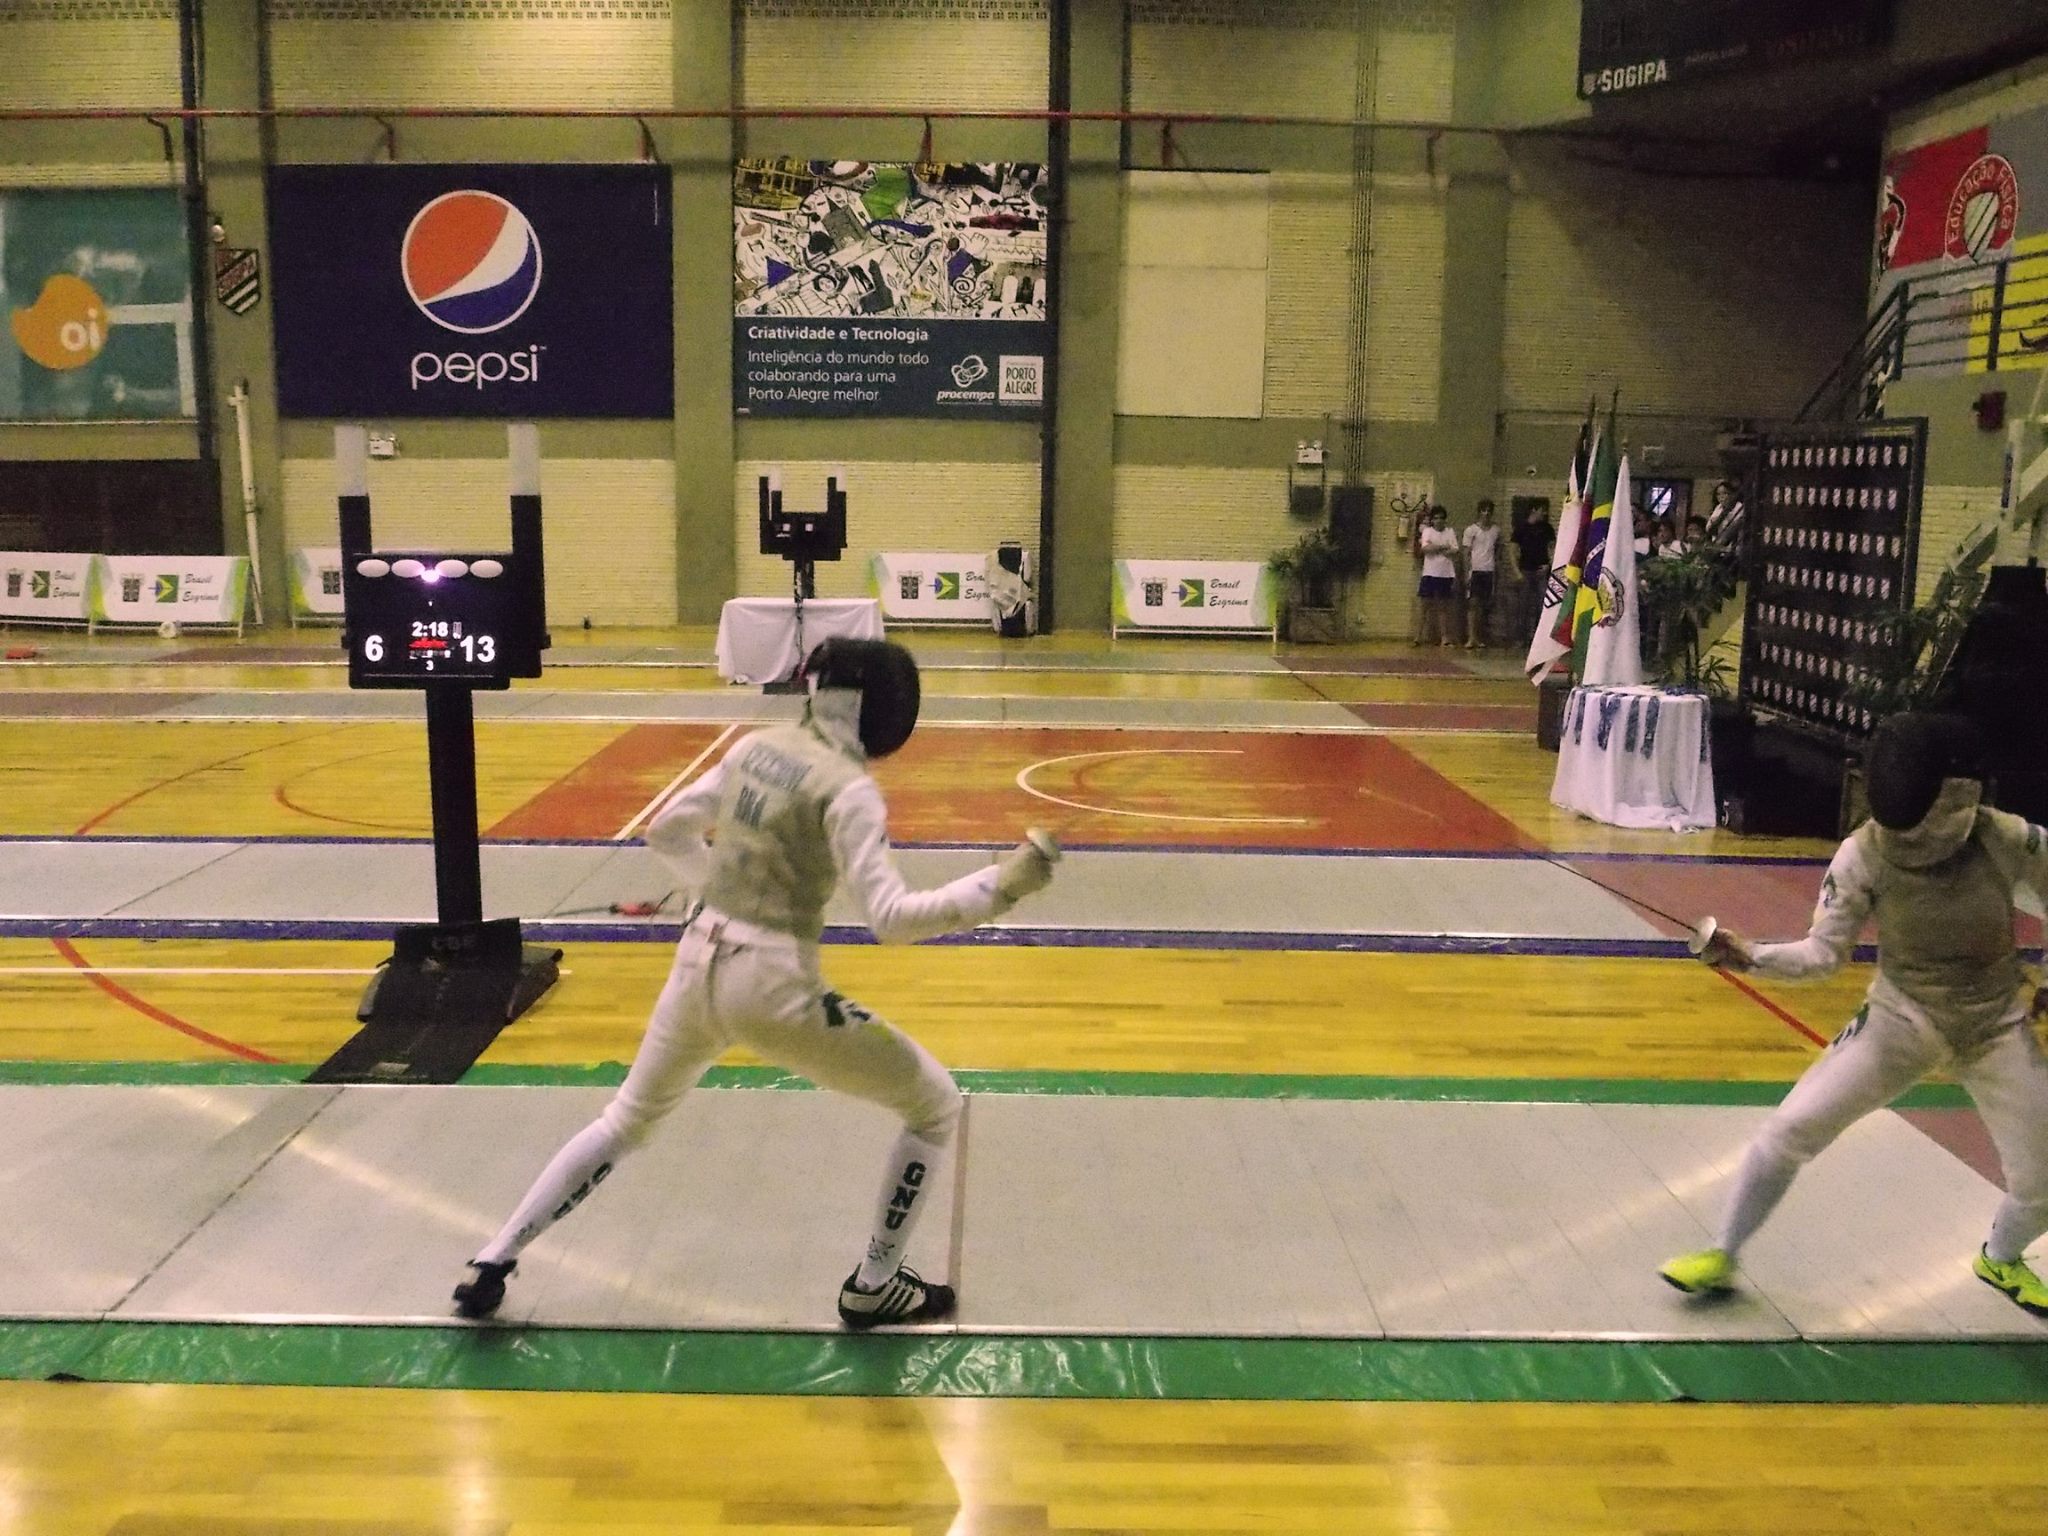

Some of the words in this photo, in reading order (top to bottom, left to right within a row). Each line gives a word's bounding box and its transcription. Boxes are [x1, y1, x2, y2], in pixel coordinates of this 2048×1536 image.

[1601, 59, 1666, 91] SOGIPA
[61, 308, 100, 352] oi
[748, 326, 835, 340] Criatividade
[839, 330, 848, 340] e
[852, 327, 929, 344] Tecnologia
[748, 350, 823, 366] Inteligência
[826, 351, 844, 364] do
[847, 352, 895, 364] mundo
[899, 352, 929, 365] todo
[411, 344, 538, 390] pepsi
[1006, 367, 1037, 381] PORTO
[748, 369, 830, 382] colaborando
[834, 371, 863, 384] para
[867, 373, 896, 383] uma
[748, 387, 783, 400] Porto
[786, 387, 829, 403] Alegre
[936, 390, 996, 402] procempa
[1005, 381, 1038, 395] ALEGRE
[1210, 578, 1241, 589] Brasil
[1209, 595, 1248, 609] Esgrima
[411, 621, 449, 637] 2:18
[366, 634, 384, 662] 6
[460, 635, 496, 662] 13
[426, 660, 434, 671] 3
[884, 1161, 927, 1231] GNU
